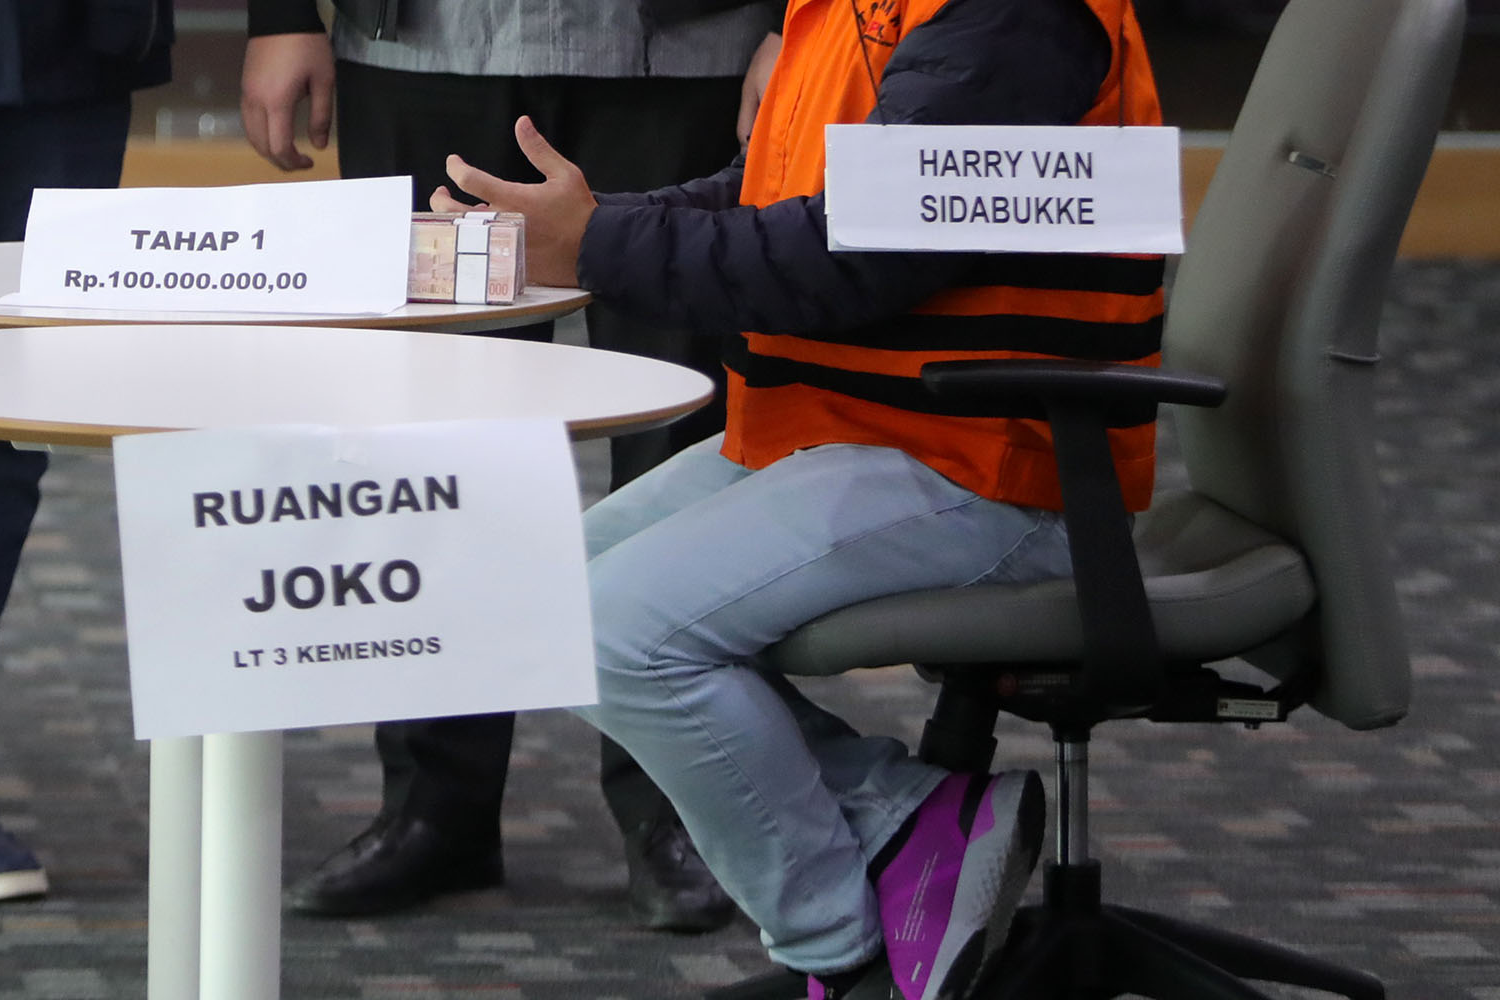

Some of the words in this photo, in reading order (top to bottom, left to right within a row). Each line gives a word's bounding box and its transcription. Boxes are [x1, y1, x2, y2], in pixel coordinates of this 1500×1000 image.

[919, 149, 1023, 178] HARRY
[1031, 150, 1094, 179] VAN
[919, 194, 1096, 225] SIDABUKKE
[130, 229, 240, 252] TAHAP
[250, 229, 266, 251] 1
[63, 269, 309, 293] Rp.100.000.000,00
[192, 475, 461, 529] RUANGAN
[243, 559, 422, 613] JOKO
[233, 649, 265, 669] LT
[273, 647, 289, 666] 3
[296, 636, 443, 665] KEMENSOS
